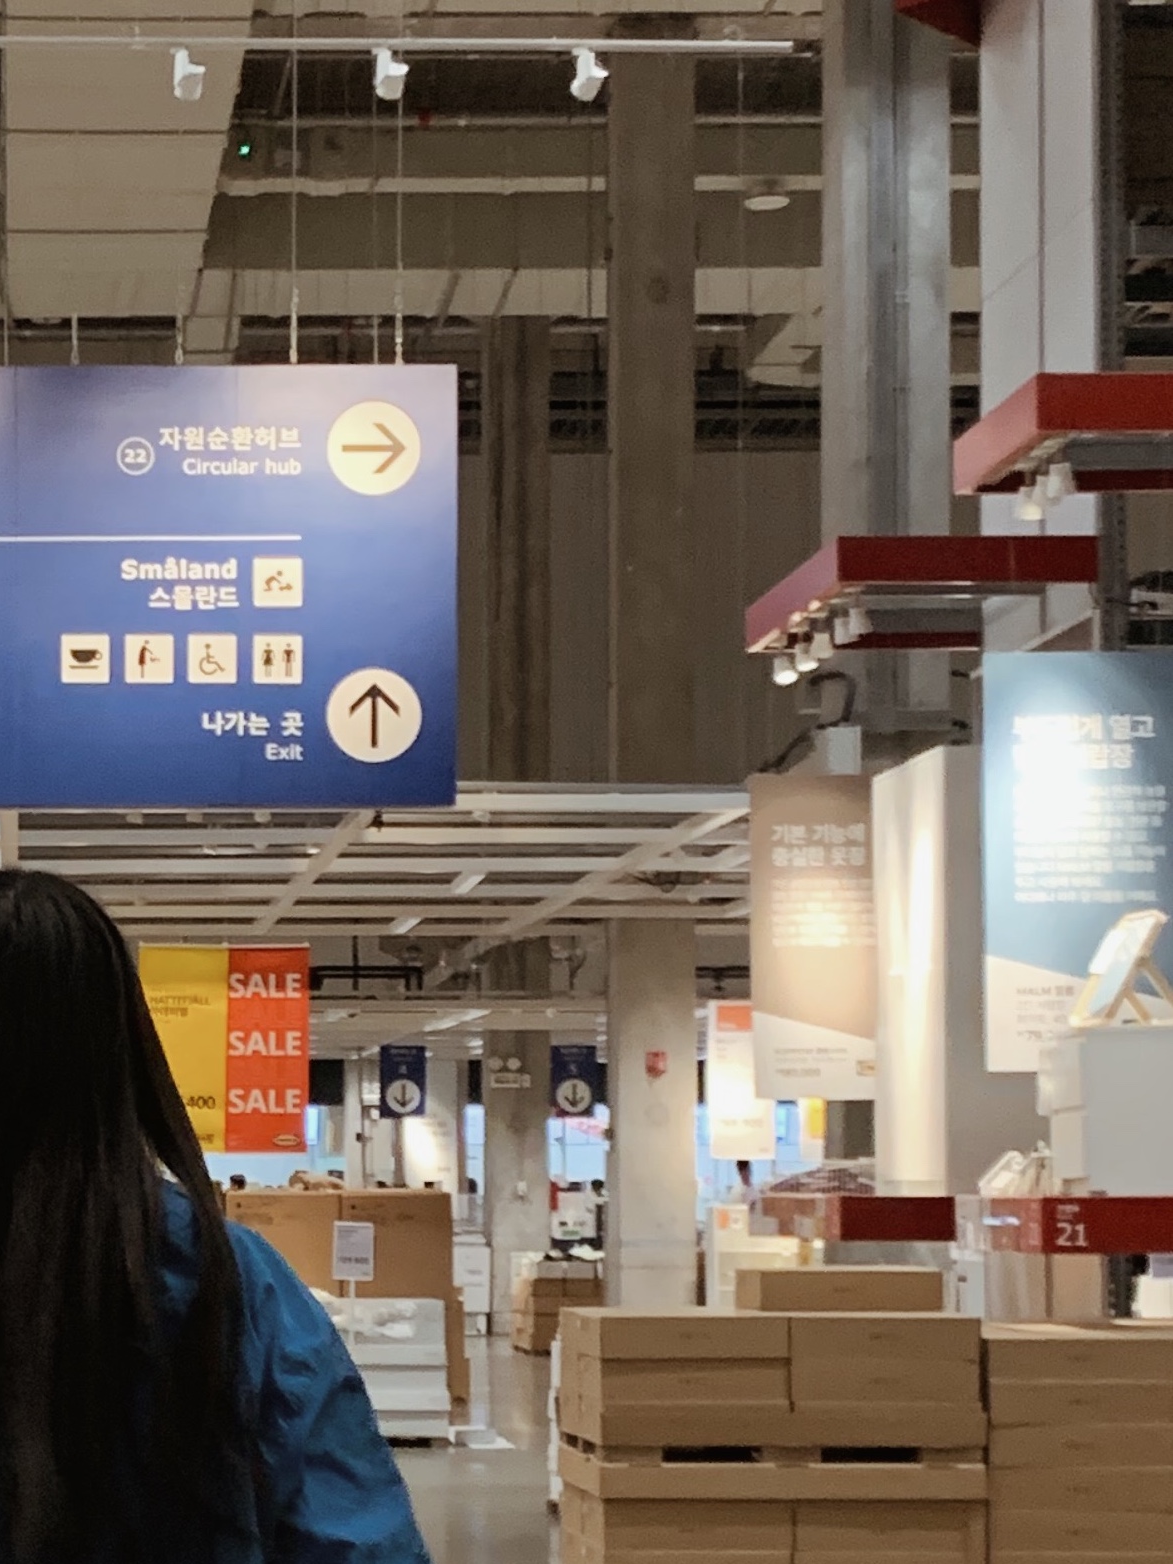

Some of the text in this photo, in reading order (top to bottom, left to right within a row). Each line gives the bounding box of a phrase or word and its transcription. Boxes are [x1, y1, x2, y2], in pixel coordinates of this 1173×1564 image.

[159, 426, 302, 451] 자원순환허브
[124, 449, 147, 464] 22
[182, 458, 302, 475] Circular hub
[120, 556, 238, 580] Småland
[147, 584, 240, 610] 스몰란드
[201, 711, 305, 737] 나가는 곳
[264, 743, 304, 760] Exit
[228, 973, 302, 999] SALE
[228, 1031, 302, 1057] SALE
[228, 1088, 302, 1114] SALE
[1055, 1222, 1089, 1247] 21
